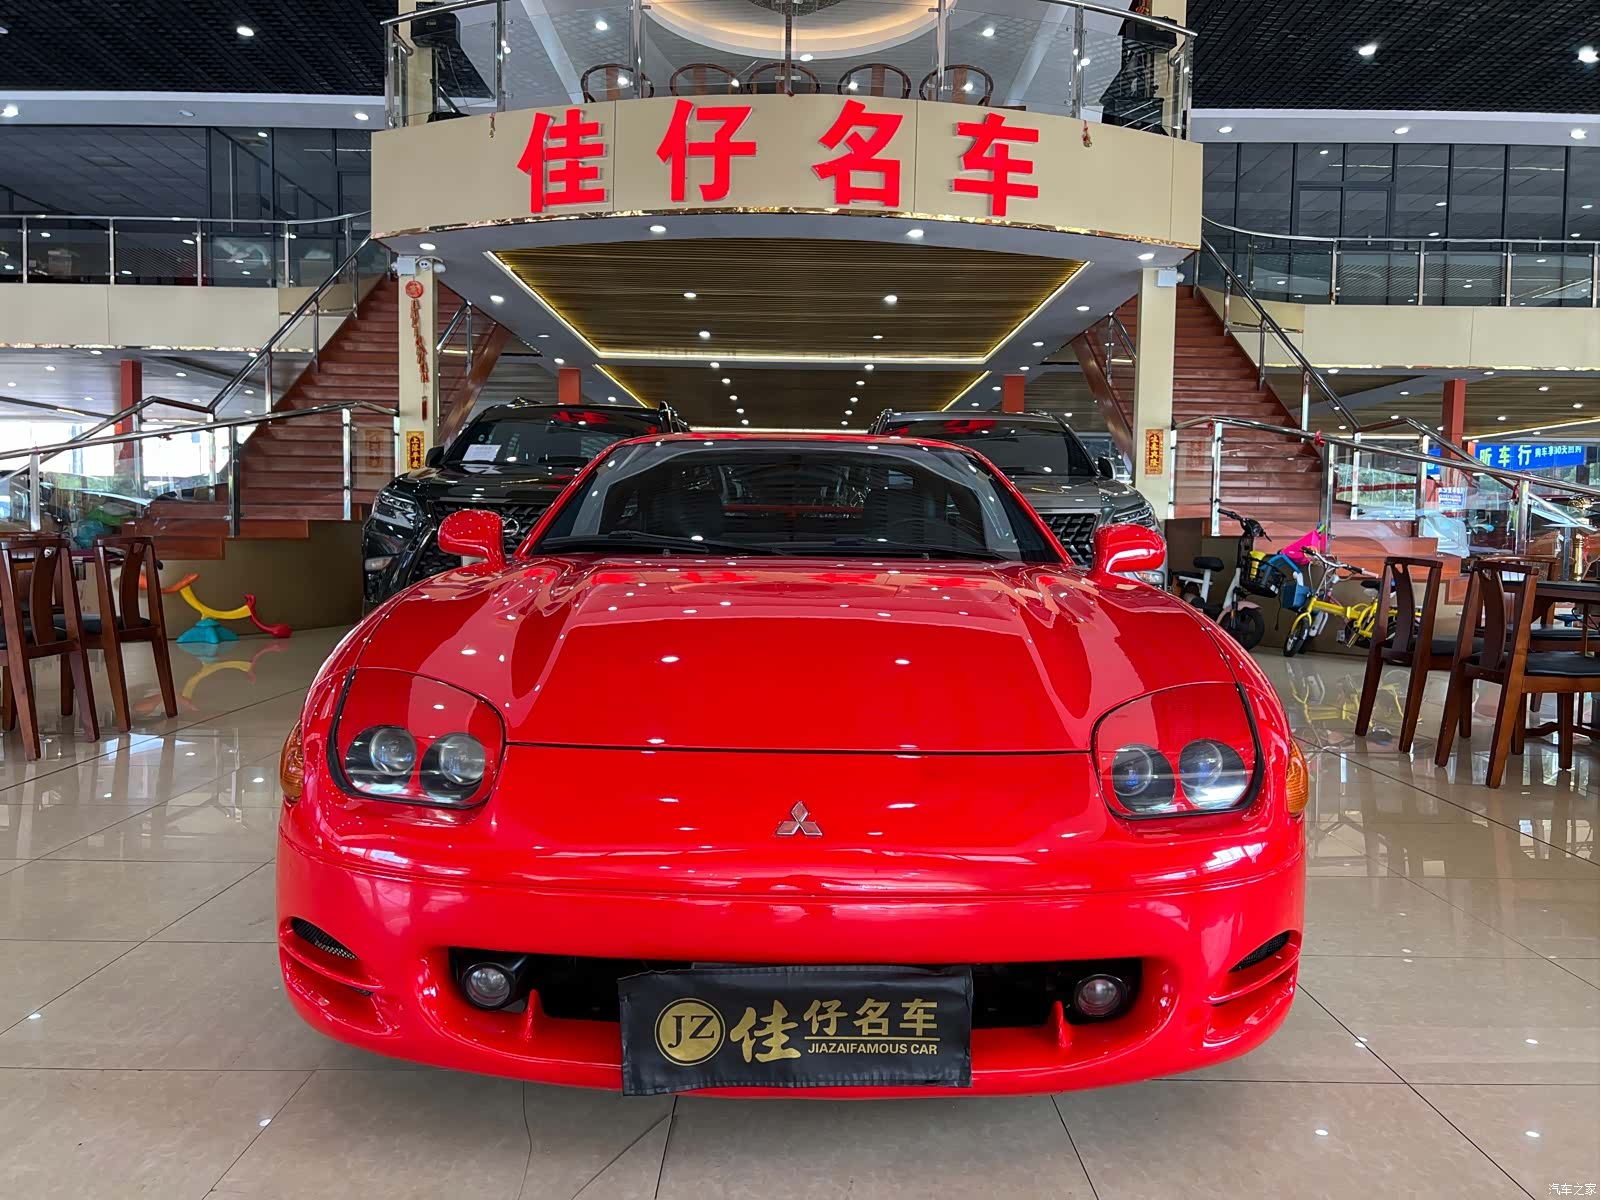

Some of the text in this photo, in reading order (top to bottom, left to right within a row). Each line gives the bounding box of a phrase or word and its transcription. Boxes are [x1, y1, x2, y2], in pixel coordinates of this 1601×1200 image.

[518, 99, 1039, 217] 佳仔名车
[669, 1014, 715, 1048] JZ
[807, 1042, 938, 1055] JIAZAIFAMOUS CAR
